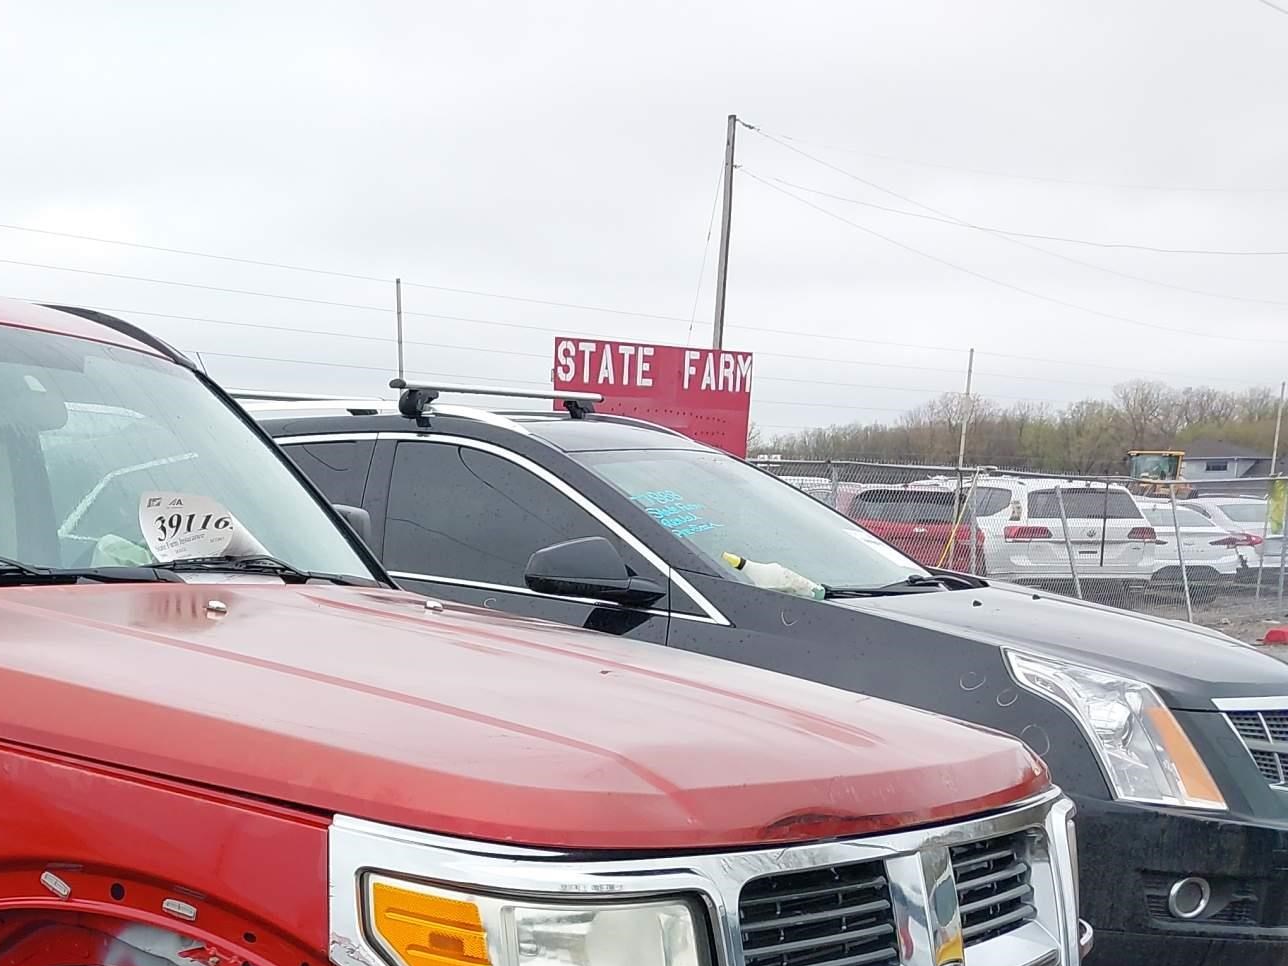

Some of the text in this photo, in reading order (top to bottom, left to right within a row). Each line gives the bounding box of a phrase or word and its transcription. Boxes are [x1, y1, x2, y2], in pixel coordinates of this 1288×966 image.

[556, 340, 753, 393] STATE FARM
[154, 512, 234, 542] 39116
